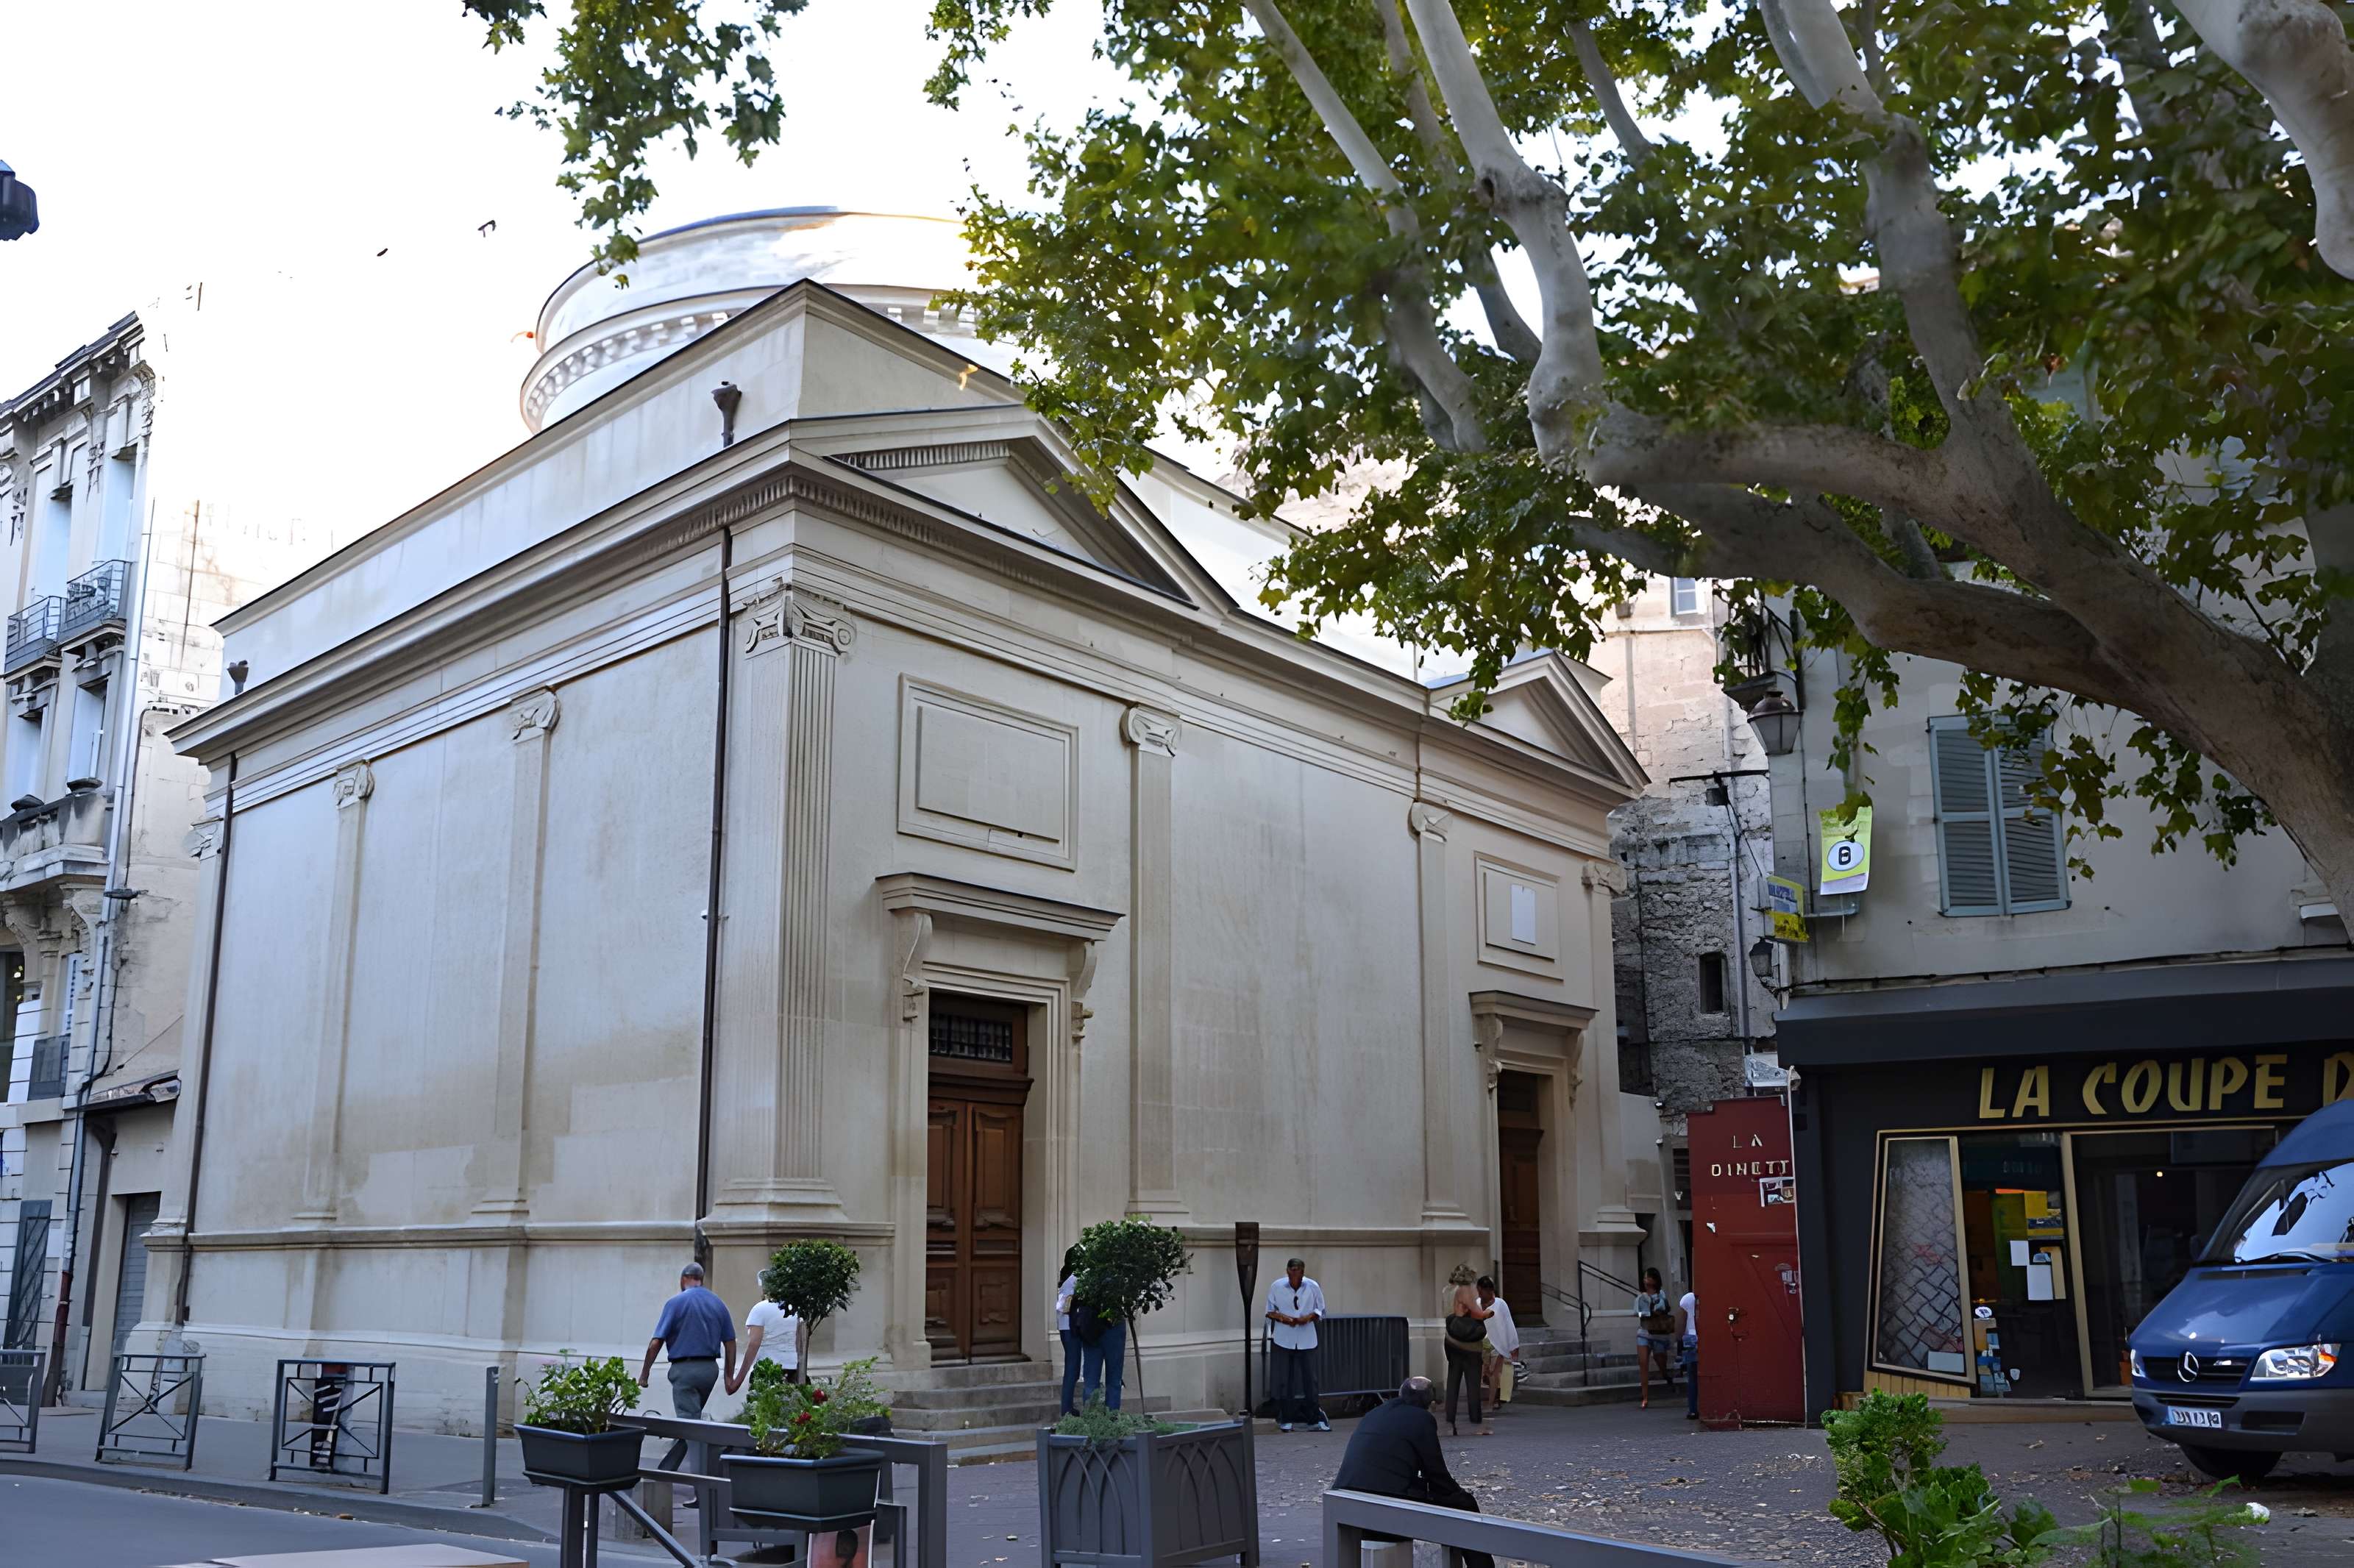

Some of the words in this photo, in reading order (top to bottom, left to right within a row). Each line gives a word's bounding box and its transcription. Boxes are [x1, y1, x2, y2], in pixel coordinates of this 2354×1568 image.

[1979, 1065, 2049, 1119] LA
[2082, 1054, 2288, 1115] COUPE
[1732, 1133, 1763, 1148] LA
